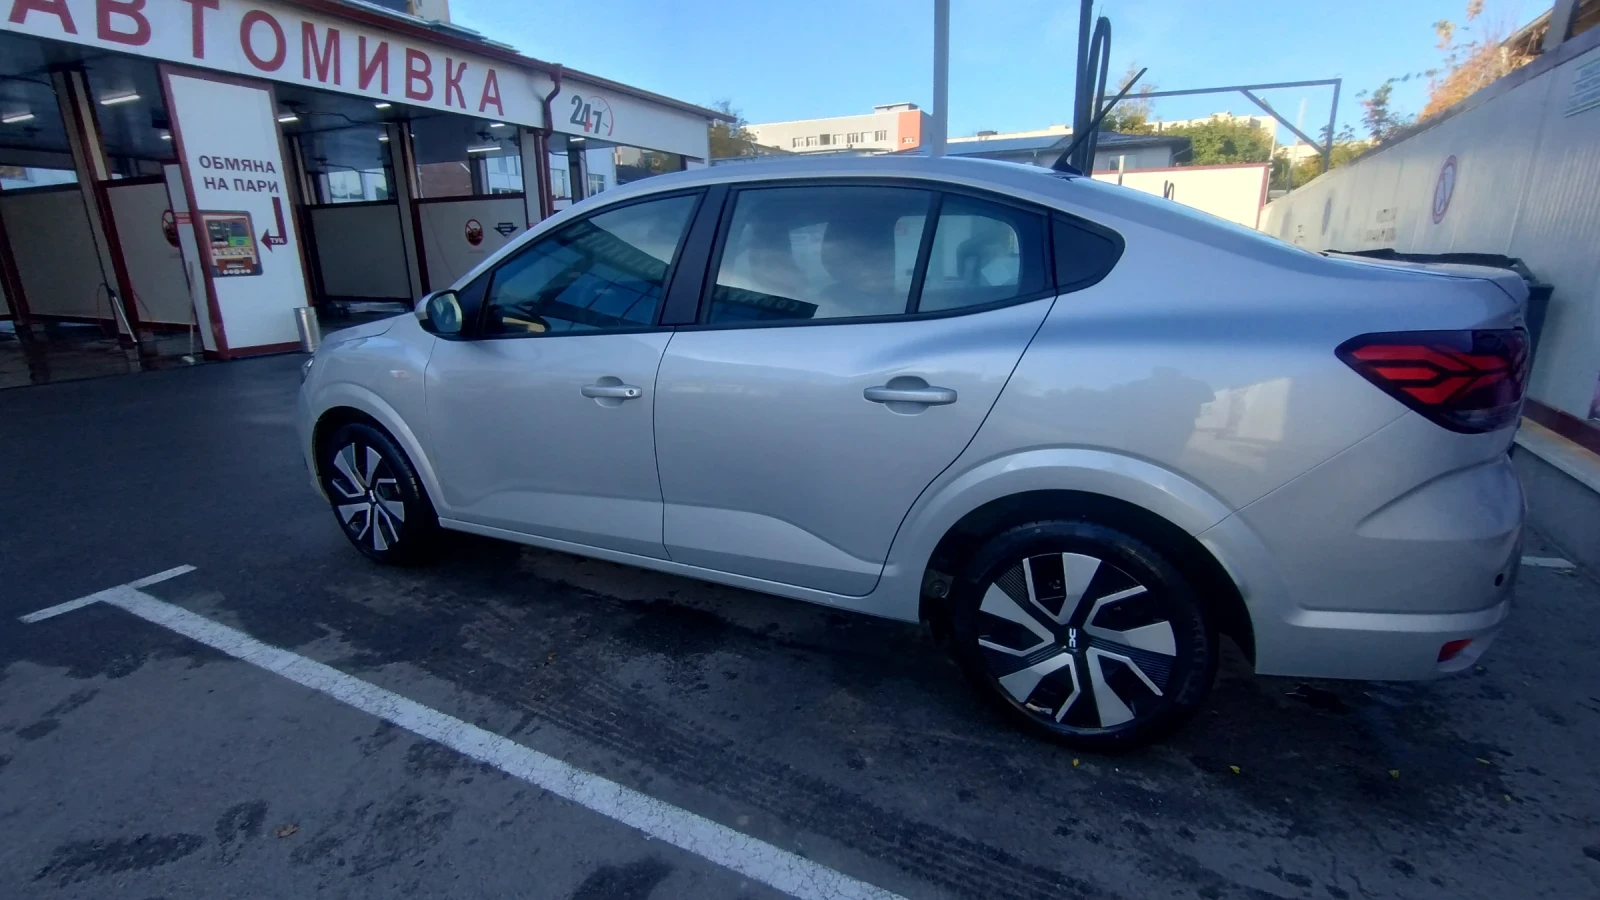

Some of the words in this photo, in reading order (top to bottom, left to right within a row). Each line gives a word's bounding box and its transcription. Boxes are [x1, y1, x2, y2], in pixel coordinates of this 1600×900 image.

[199, 155, 277, 174] ОБМЯНА
[203, 176, 230, 191] НА
[233, 178, 280, 194] ПАРИ
[269, 237, 285, 245] ТУК
